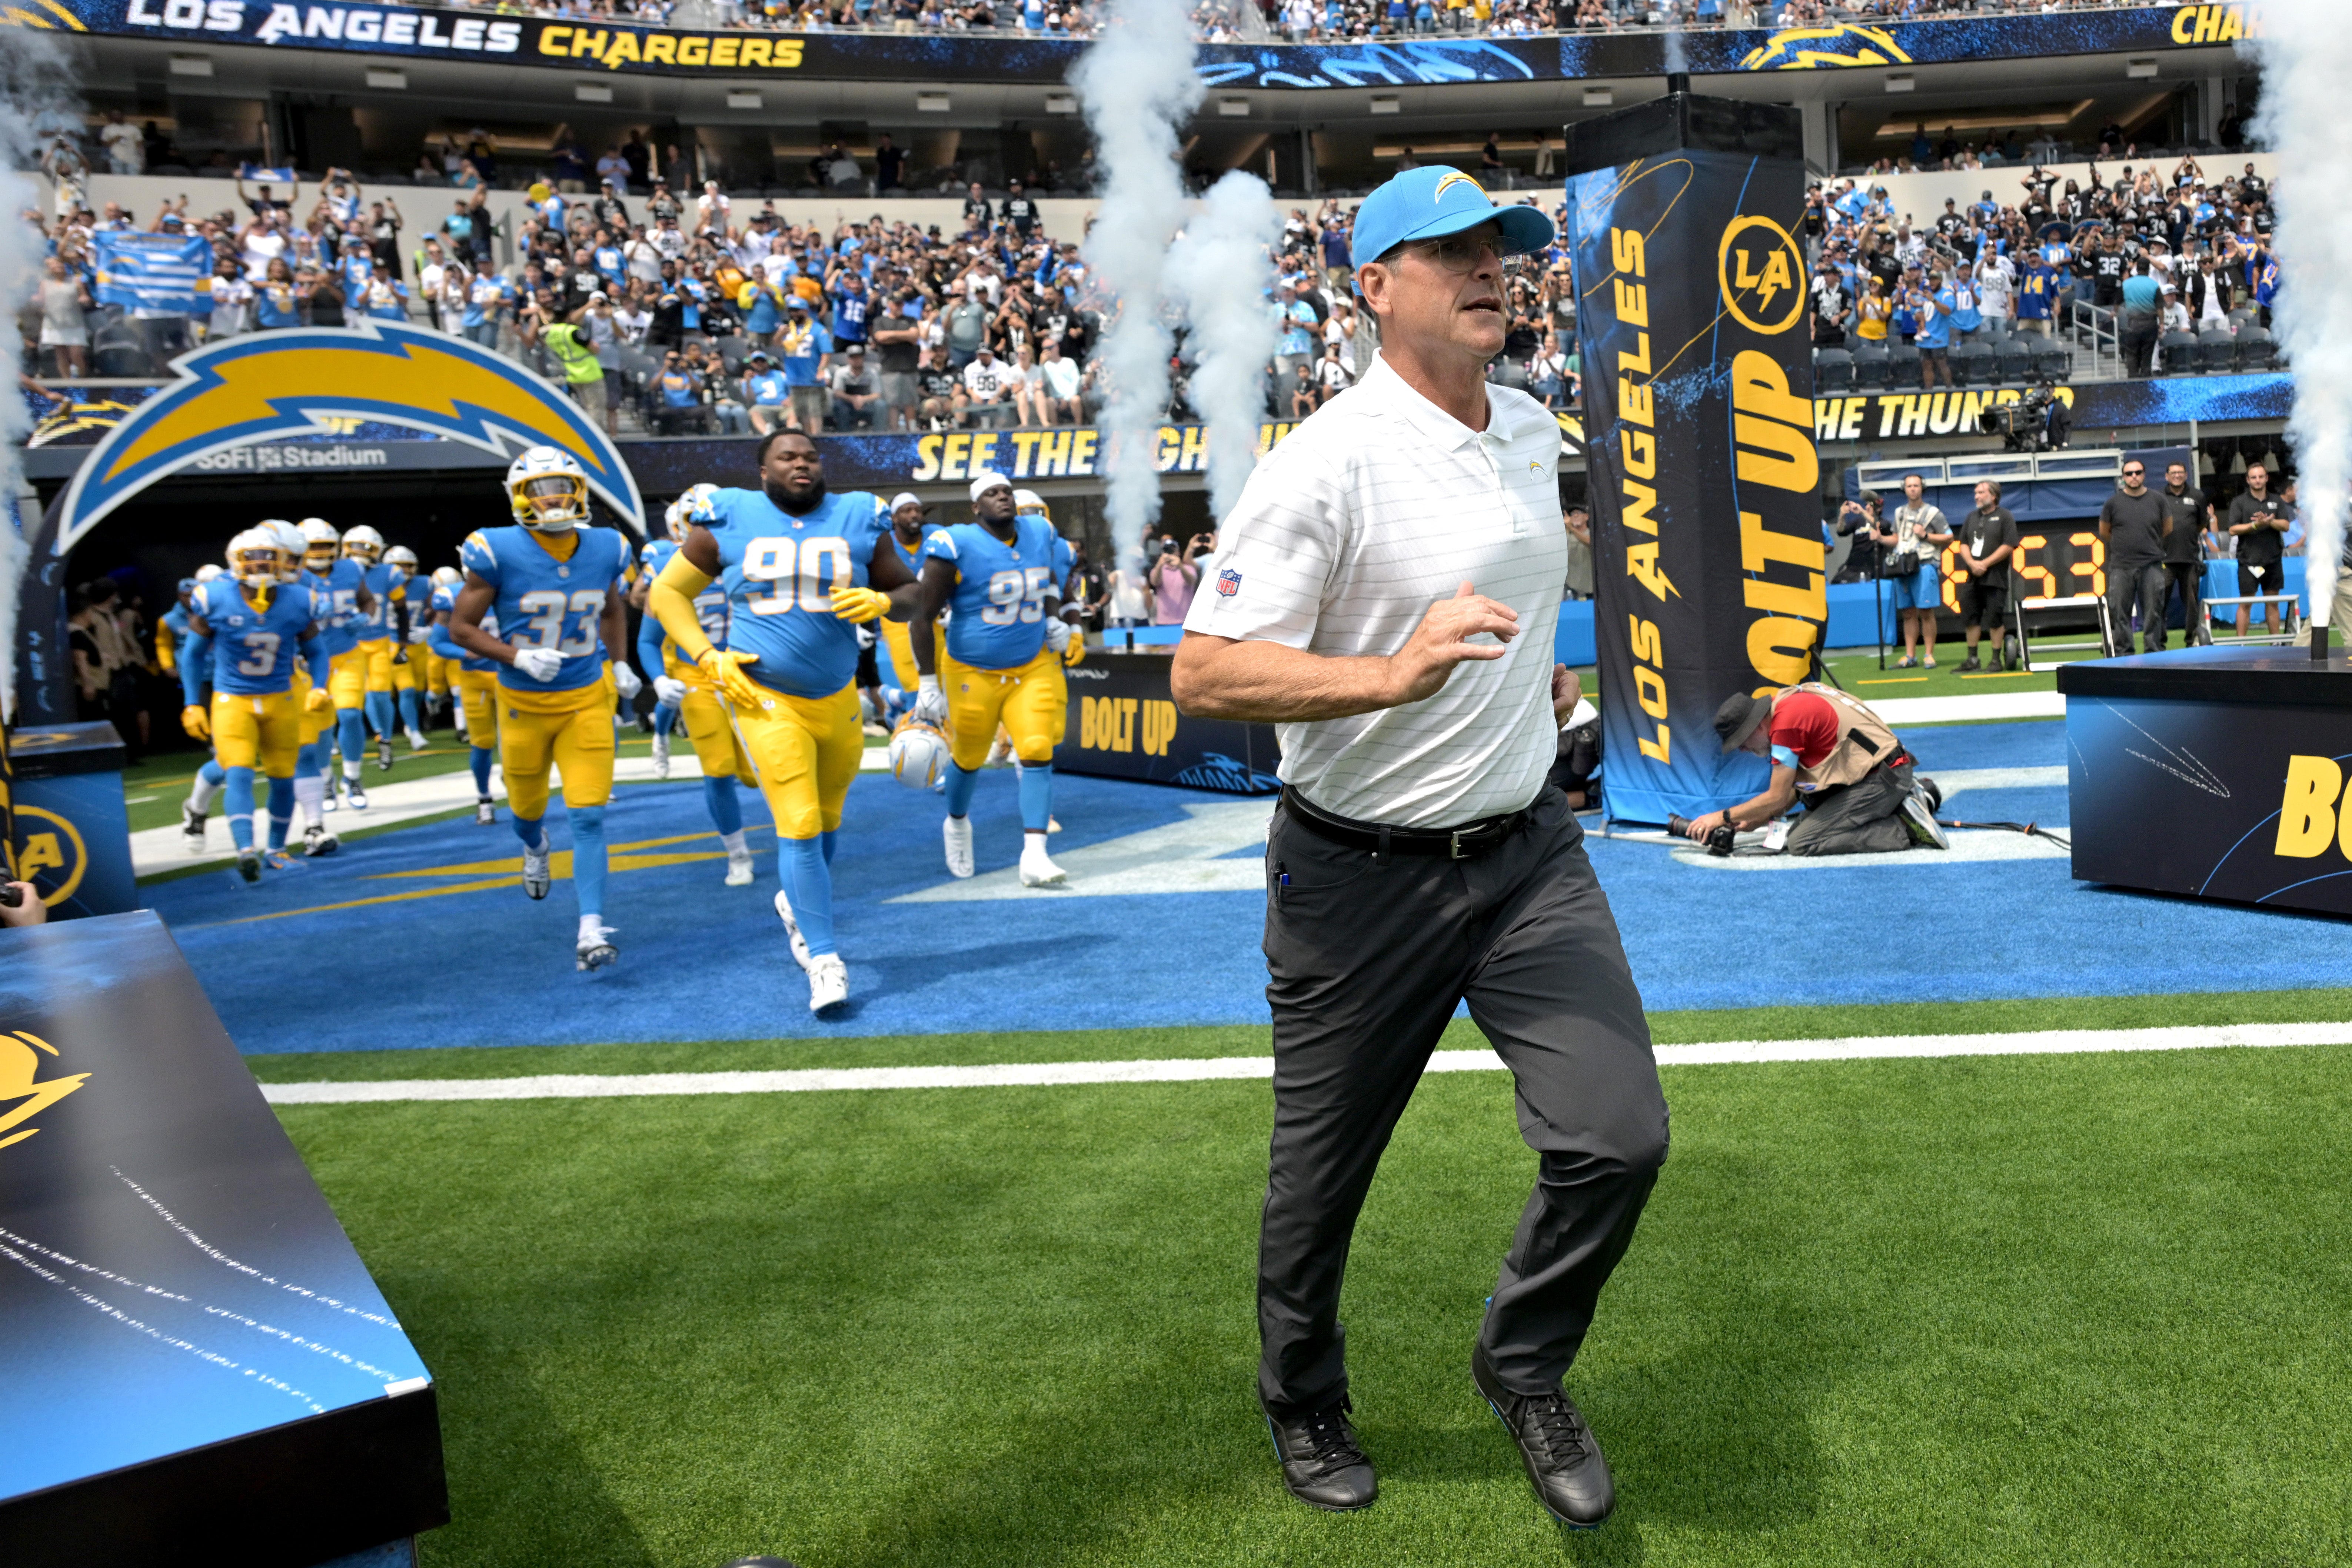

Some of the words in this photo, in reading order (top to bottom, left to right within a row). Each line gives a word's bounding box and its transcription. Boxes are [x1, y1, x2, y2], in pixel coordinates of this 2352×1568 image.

[126, 0, 247, 31] LOS
[255, 3, 522, 53] ANGELES
[538, 25, 805, 70] CHARGERS
[2149, 218, 2168, 235] 34
[1736, 249, 1792, 313] LA
[2024, 275, 2043, 295] 14
[2098, 256, 2121, 276] 32
[1956, 290, 1973, 311] 10
[761, 380, 777, 399] 3
[1611, 227, 1682, 602] ANGELES
[1732, 349, 1819, 493] UP
[195, 447, 254, 470] SoFi
[283, 446, 387, 467] Stadium
[912, 434, 998, 481] SEE
[1011, 430, 1098, 477] THE
[743, 537, 852, 616] 90
[981, 566, 1050, 626] 95
[1217, 578, 1235, 594] NFL
[1740, 510, 1828, 699] OLT
[510, 589, 606, 658] 33
[239, 632, 281, 676] 3
[1629, 613, 1670, 765] LOS
[1080, 696, 1138, 753] BOLT
[1142, 699, 1177, 757] UP
